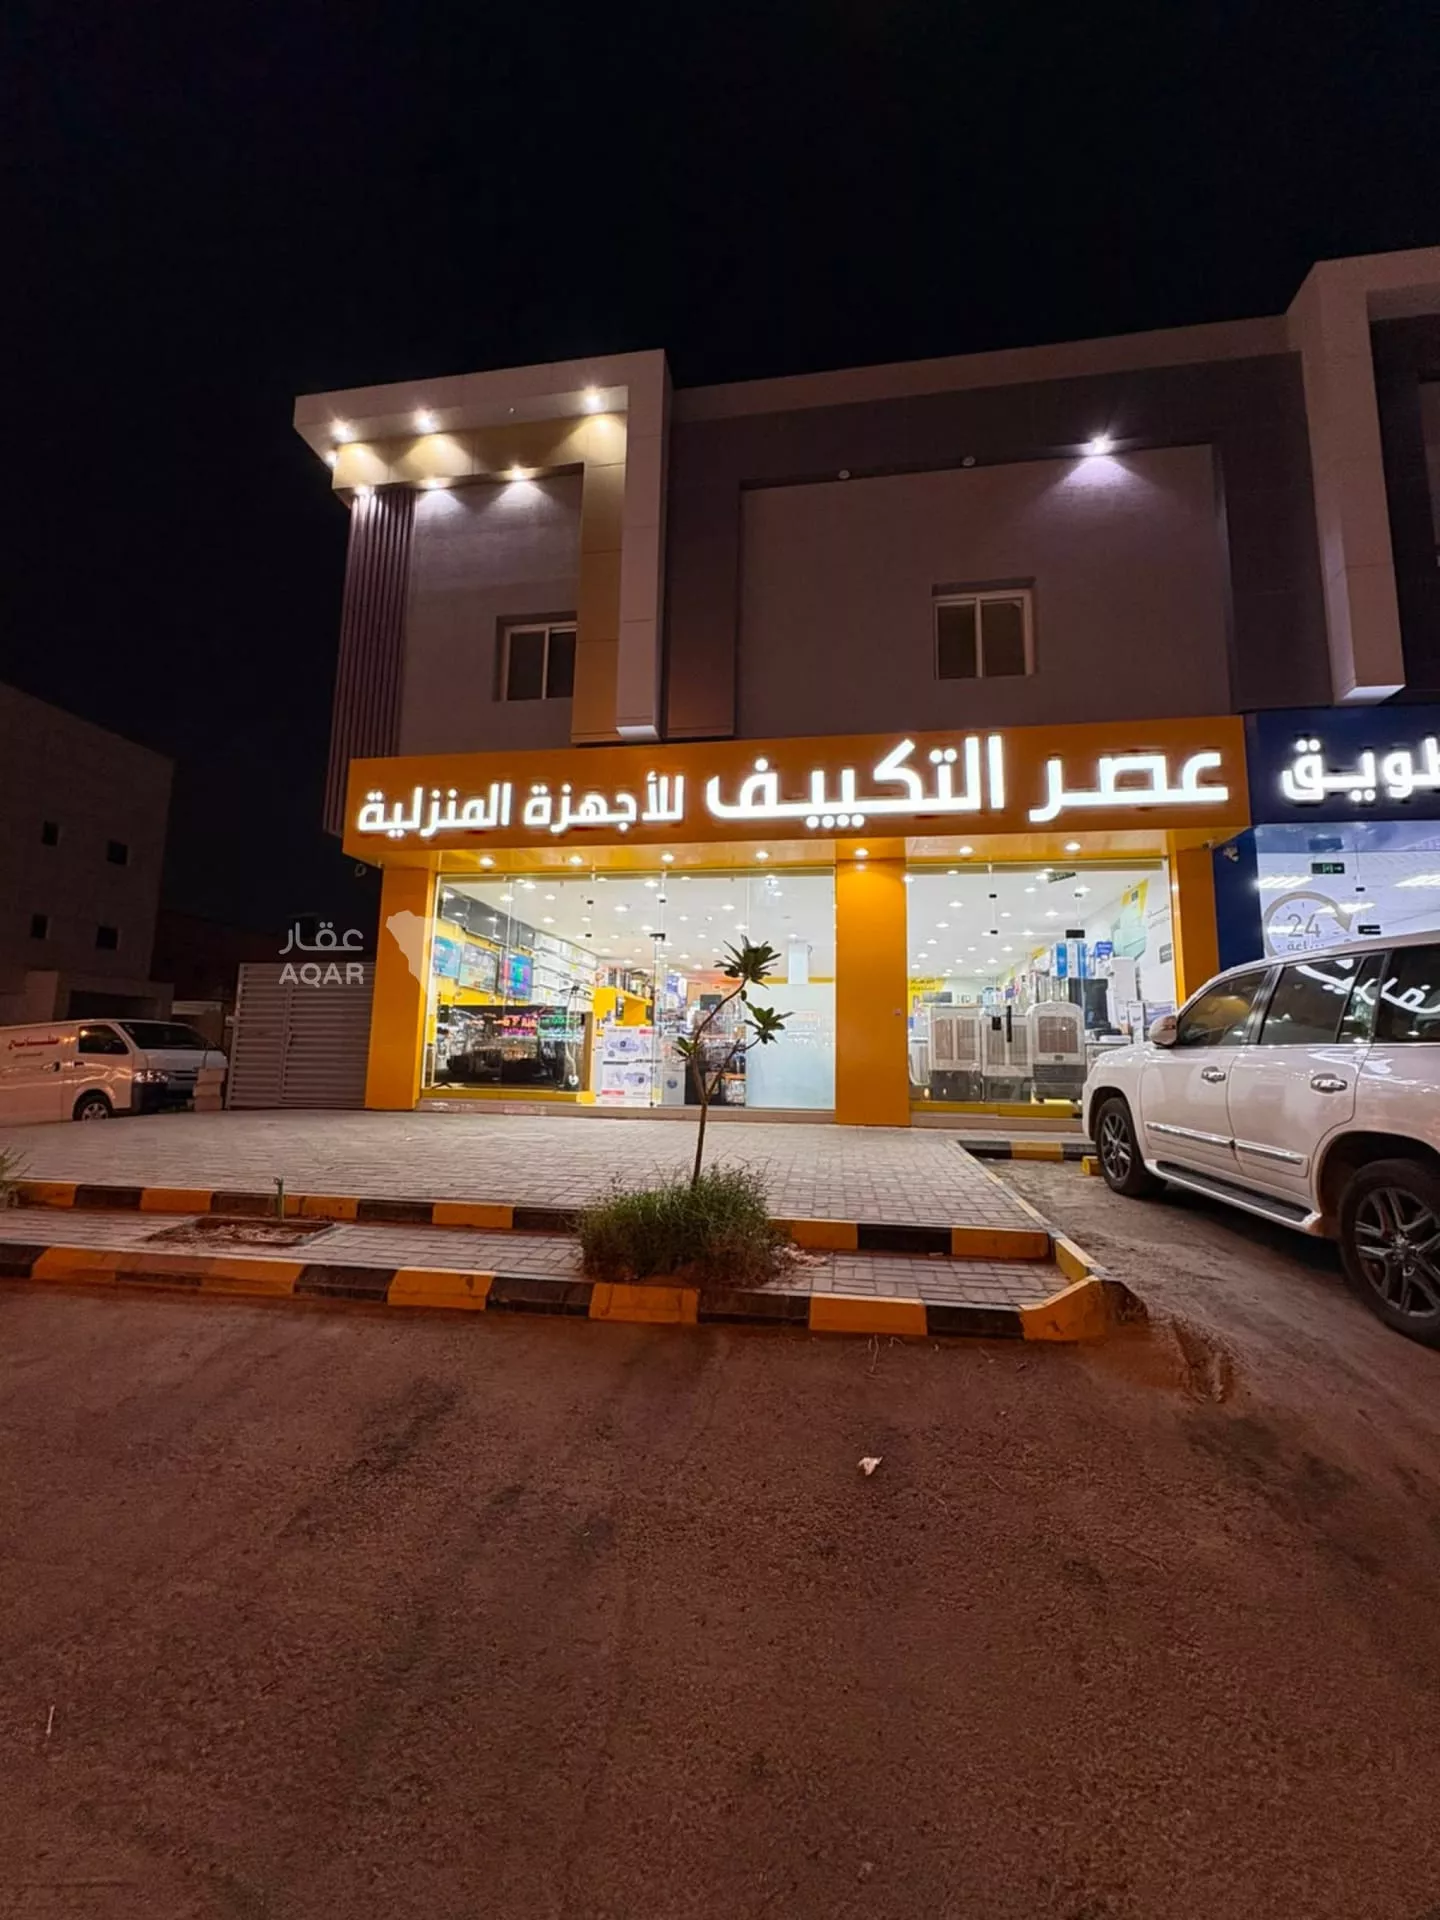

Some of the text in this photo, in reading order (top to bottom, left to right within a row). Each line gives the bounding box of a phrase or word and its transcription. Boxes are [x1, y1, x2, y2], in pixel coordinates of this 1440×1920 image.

[357, 734, 1229, 838] عصر التكييف للأجهزة المنزلية
[1287, 913, 1321, 938] 24
